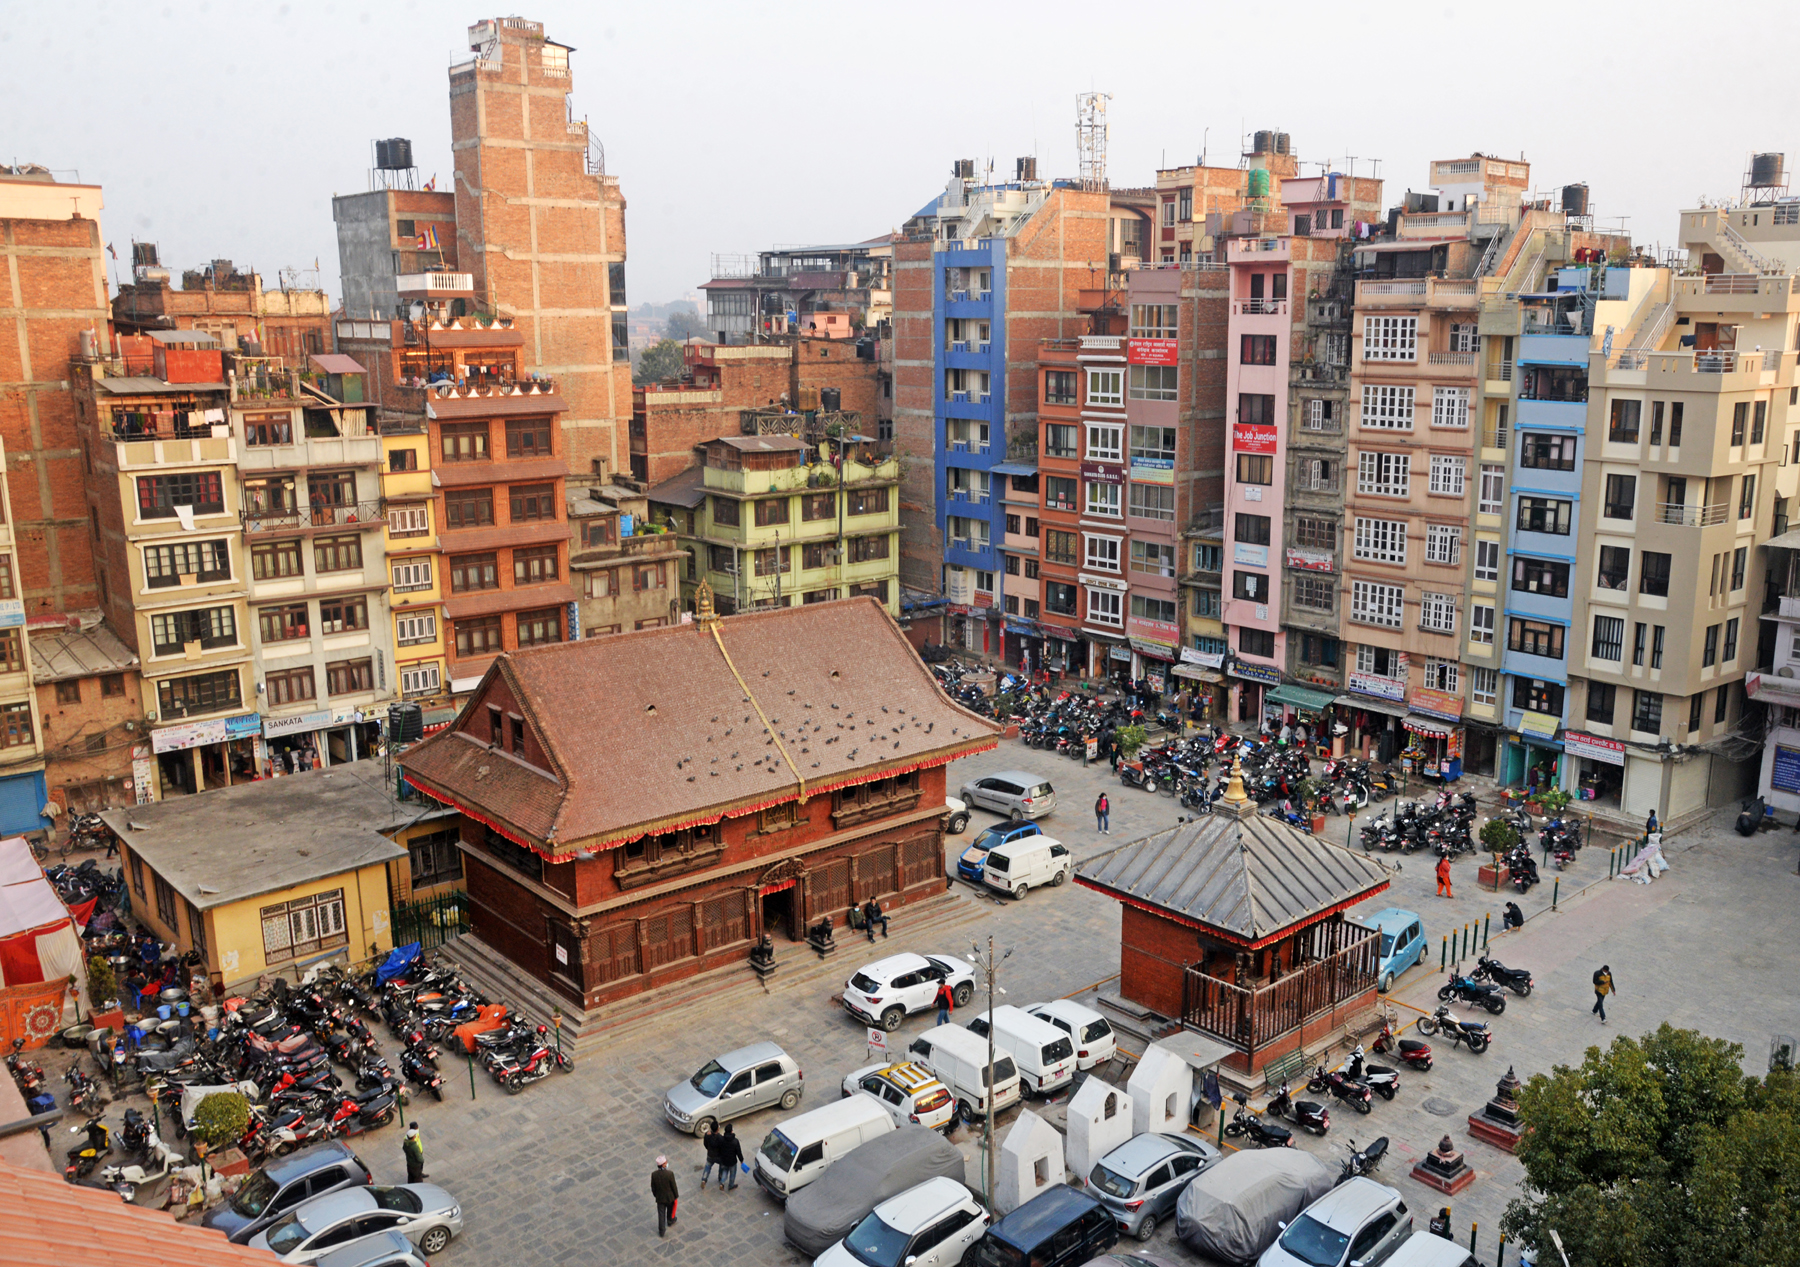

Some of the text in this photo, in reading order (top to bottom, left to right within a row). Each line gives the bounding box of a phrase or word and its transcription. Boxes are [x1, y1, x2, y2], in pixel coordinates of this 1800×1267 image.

[1234, 430, 1276, 441] The Job Junction
[268, 717, 303, 729] SANKATA
[303, 713, 329, 724] infosys
